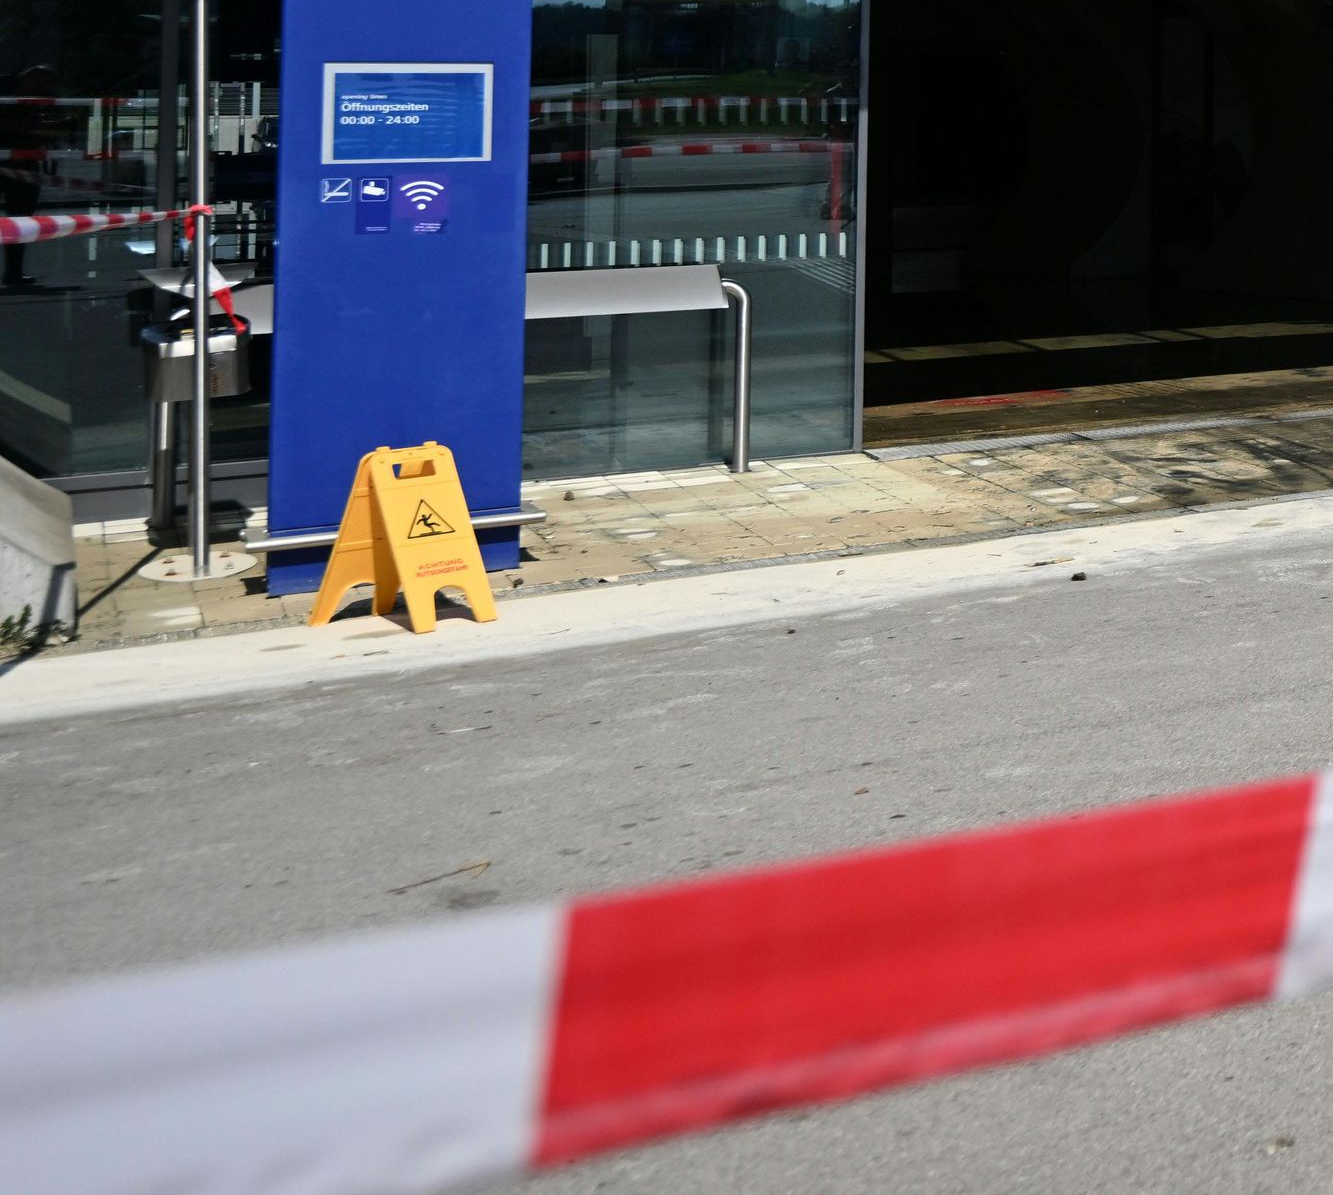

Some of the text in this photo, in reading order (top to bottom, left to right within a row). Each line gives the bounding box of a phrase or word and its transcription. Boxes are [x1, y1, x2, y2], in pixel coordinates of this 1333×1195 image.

[340, 101, 429, 113] Öffnungszeiten
[340, 115, 375, 125] 00:00
[385, 115, 420, 124] 24:00
